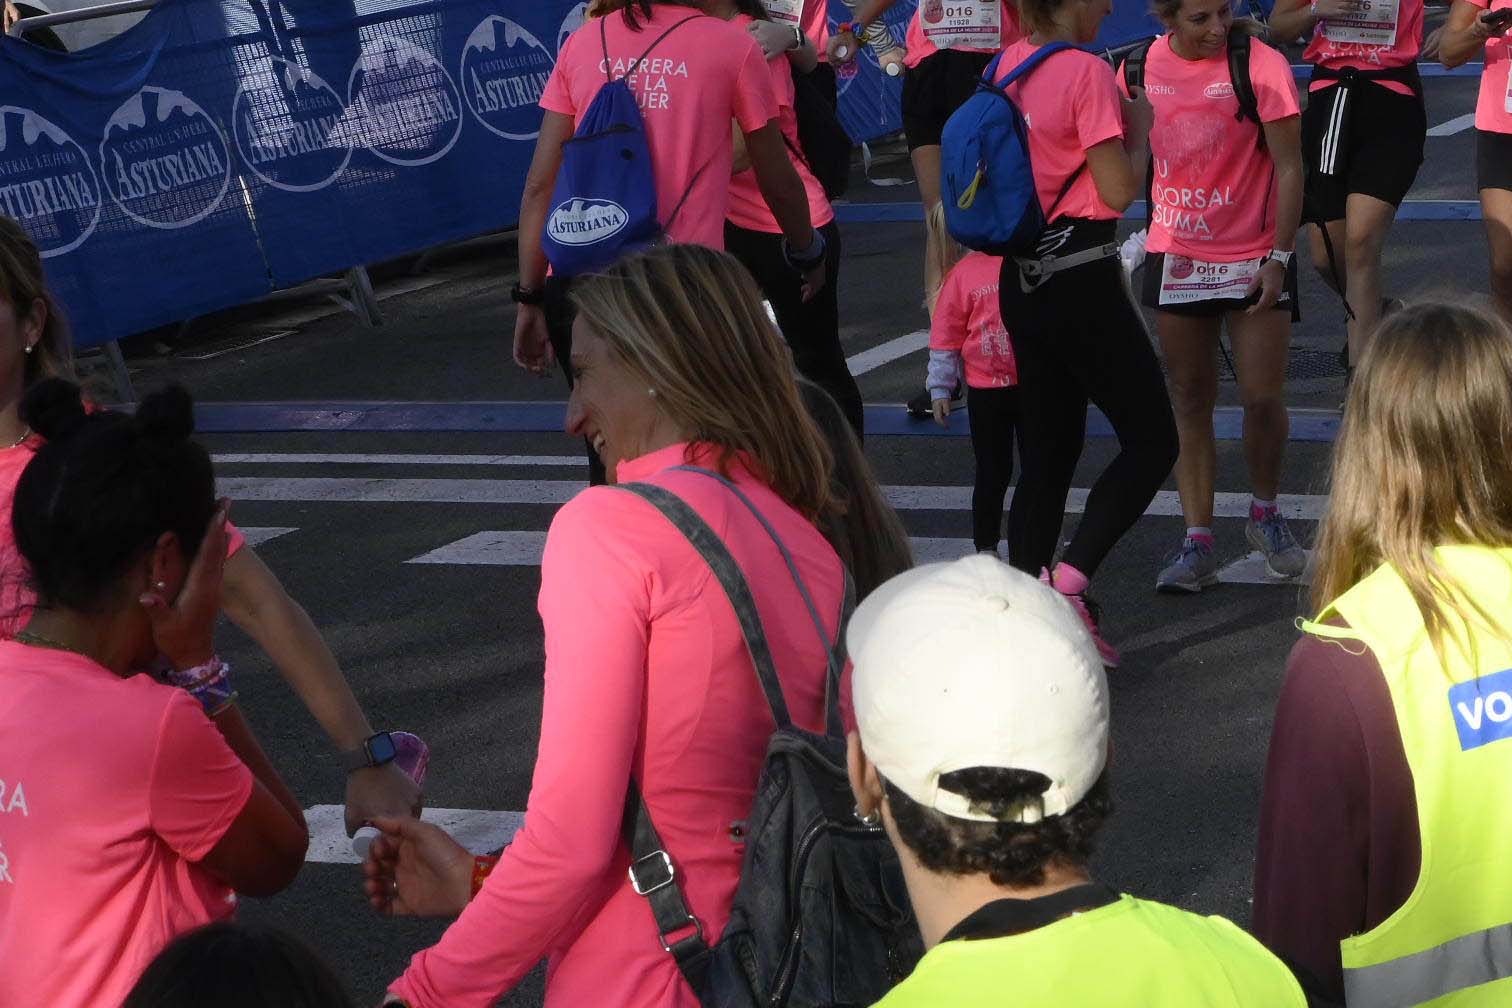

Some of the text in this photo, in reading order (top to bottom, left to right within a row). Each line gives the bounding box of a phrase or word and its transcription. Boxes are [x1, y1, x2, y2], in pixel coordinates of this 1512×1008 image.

[946, 6, 973, 17] 016
[599, 58, 689, 78] CARRERA
[471, 67, 551, 114] ASTURIAN
[644, 76, 668, 92] LA
[0, 172, 97, 219] TURIANA
[1156, 186, 1233, 209] DORSAL
[551, 214, 621, 234] ASTURIANA
[1155, 204, 1210, 233] SUMA
